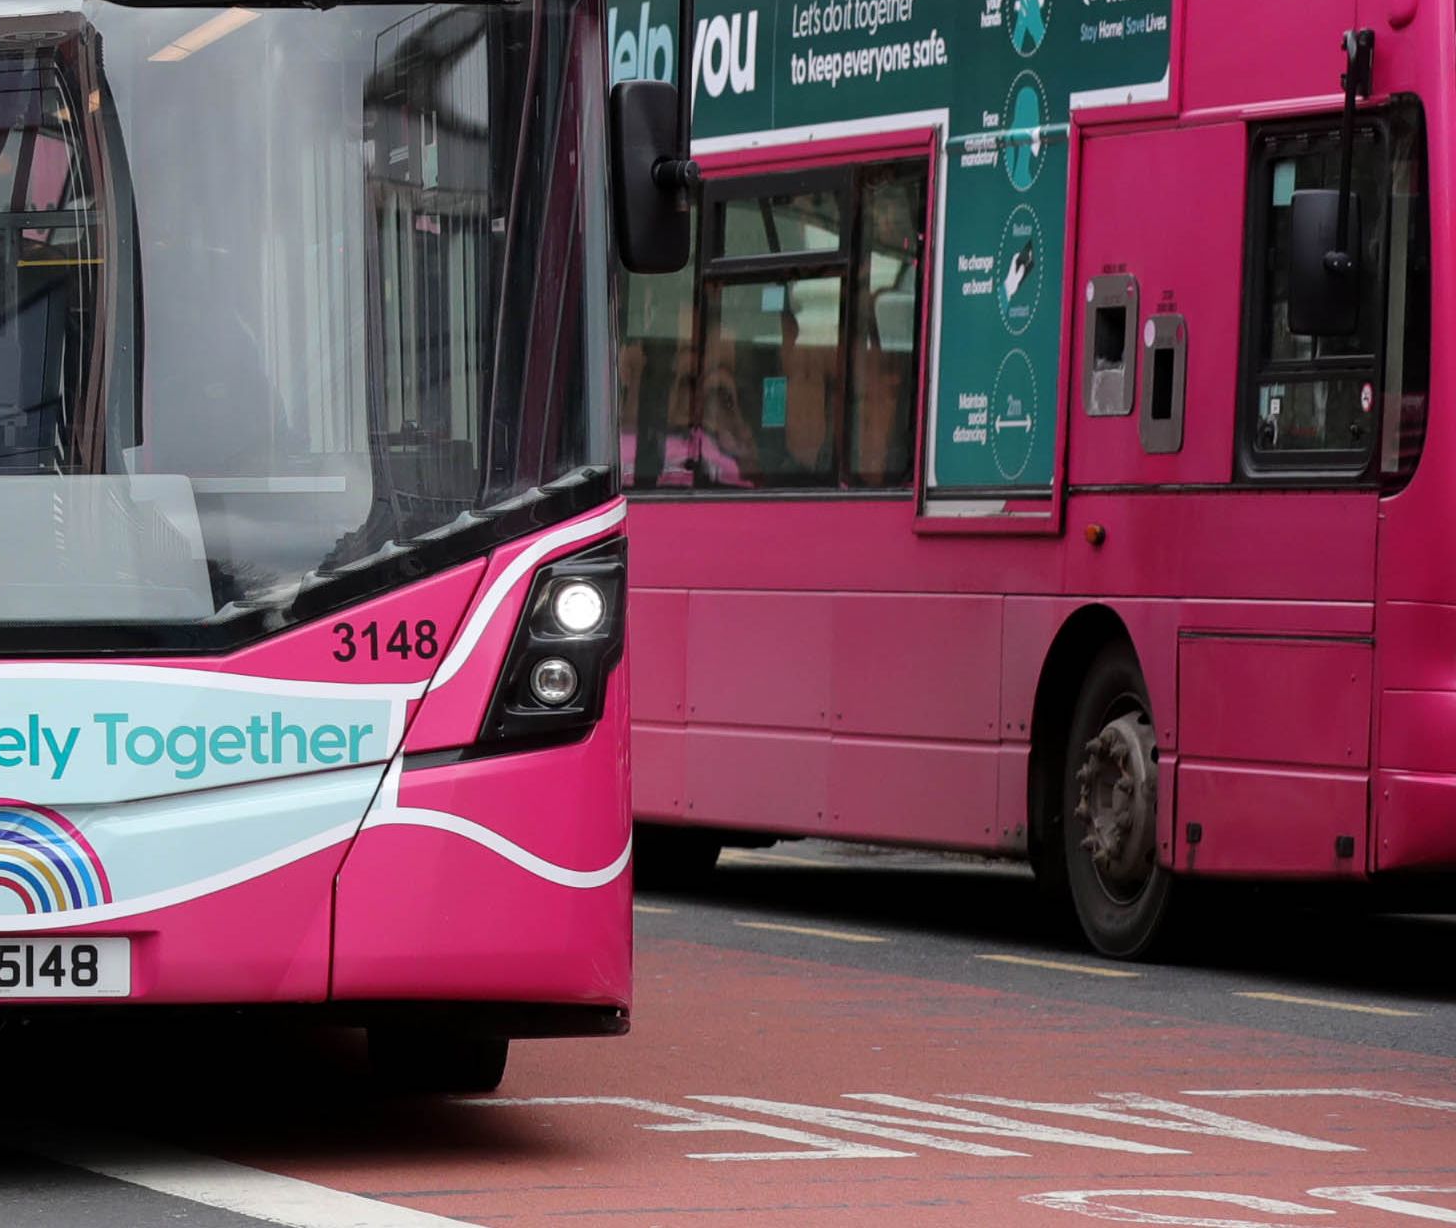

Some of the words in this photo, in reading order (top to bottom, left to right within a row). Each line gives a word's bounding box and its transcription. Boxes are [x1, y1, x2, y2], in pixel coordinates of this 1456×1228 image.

[792, 0, 821, 38] Let's
[1146, 12, 1166, 32] Lives
[608, 0, 674, 84] elp
[791, 55, 806, 85] to
[808, 48, 840, 88] keep
[841, 40, 910, 82] everyone
[913, 29, 947, 69] safe.
[1008, 394, 1022, 416] 2m
[333, 620, 438, 662] 3148
[93, 711, 374, 780] Together
